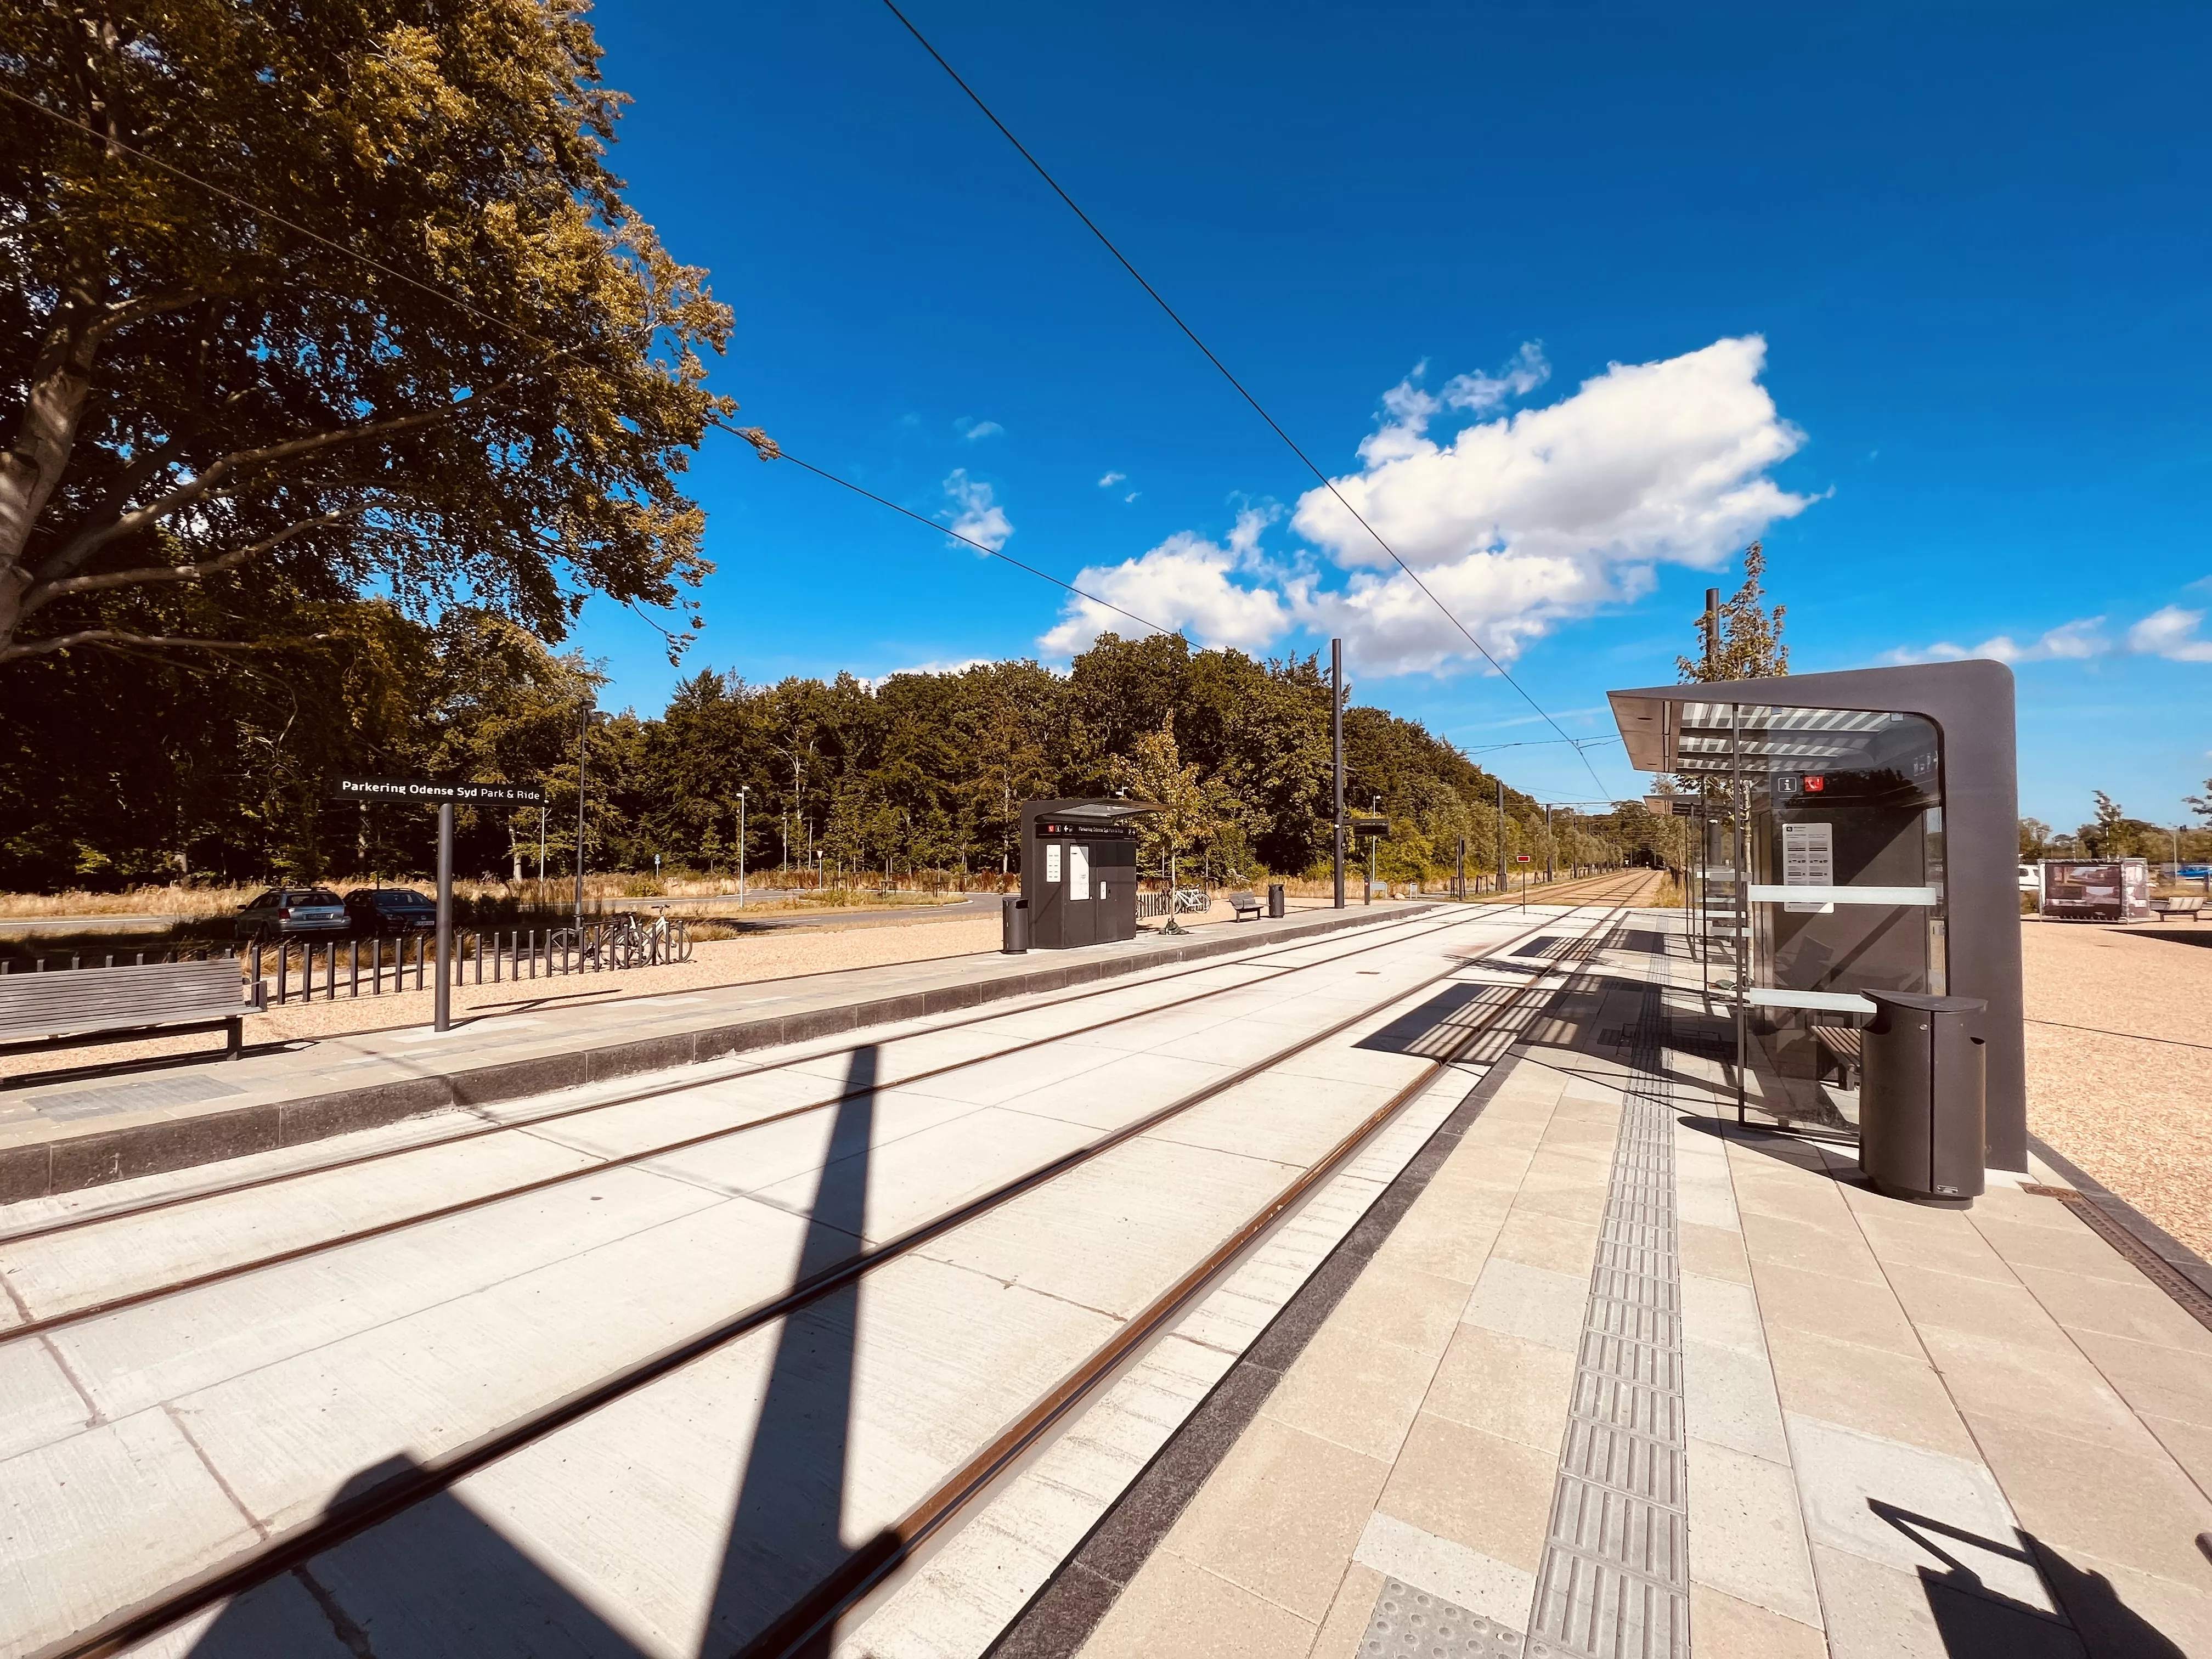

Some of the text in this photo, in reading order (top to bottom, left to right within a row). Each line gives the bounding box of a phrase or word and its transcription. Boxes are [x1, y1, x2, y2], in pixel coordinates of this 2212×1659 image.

[342, 781, 540, 800] Parkering Odense Syd Park & Ride
